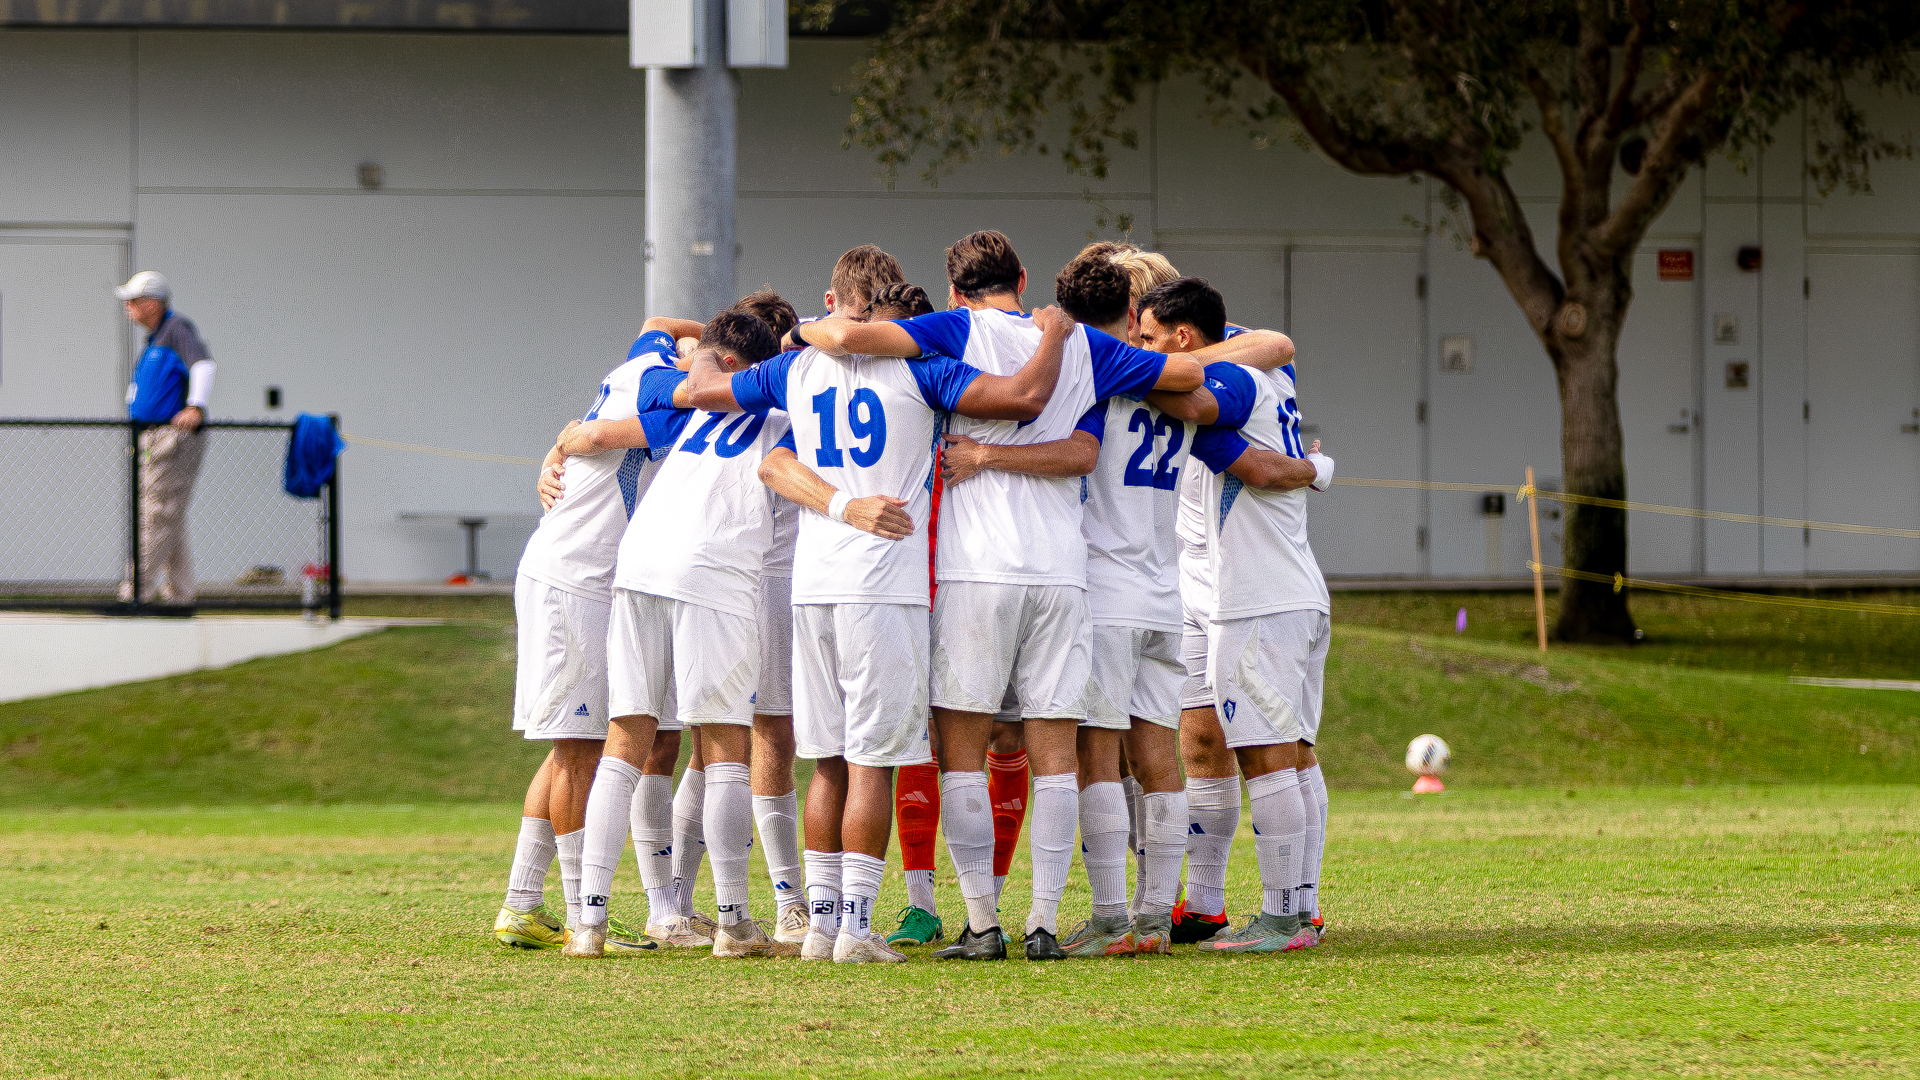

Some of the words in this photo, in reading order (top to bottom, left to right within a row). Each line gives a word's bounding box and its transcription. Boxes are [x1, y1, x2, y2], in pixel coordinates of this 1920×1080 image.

[678, 410, 768, 458] 10
[812, 386, 887, 468] 19
[1124, 407, 1184, 491] 22
[812, 900, 833, 914] FS
[1282, 889, 1290, 914] SOCKS
